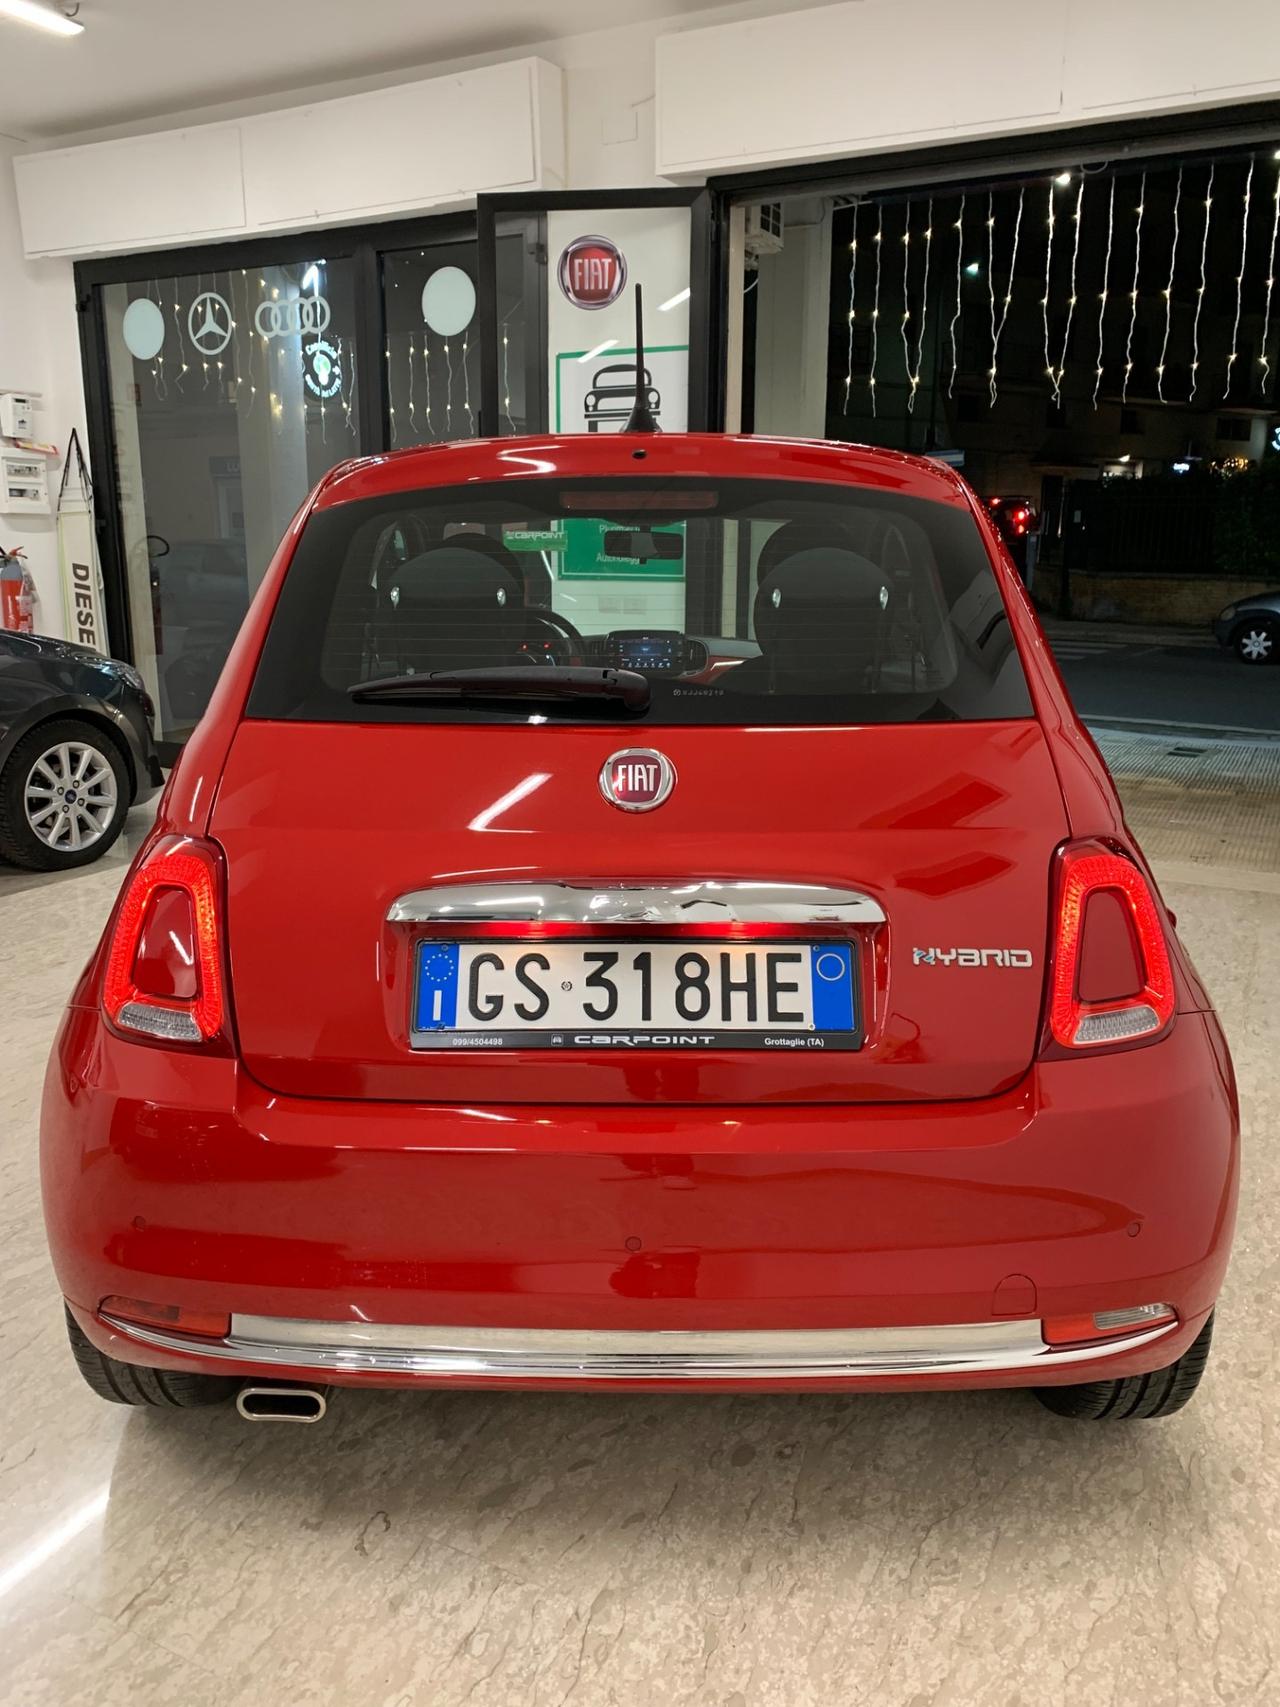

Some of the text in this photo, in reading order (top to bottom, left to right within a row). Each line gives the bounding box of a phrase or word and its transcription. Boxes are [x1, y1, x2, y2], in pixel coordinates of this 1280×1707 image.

[574, 258, 612, 291] FIAT
[71, 562, 97, 646] DIESE
[617, 764, 659, 792] FIAT
[912, 947, 1033, 967] HYBRID
[468, 951, 805, 1023] GS 318HE
[432, 990, 443, 1021] I
[452, 1037, 503, 1046] 099/4504498
[764, 1037, 825, 1048] Grottaglie (TA)
